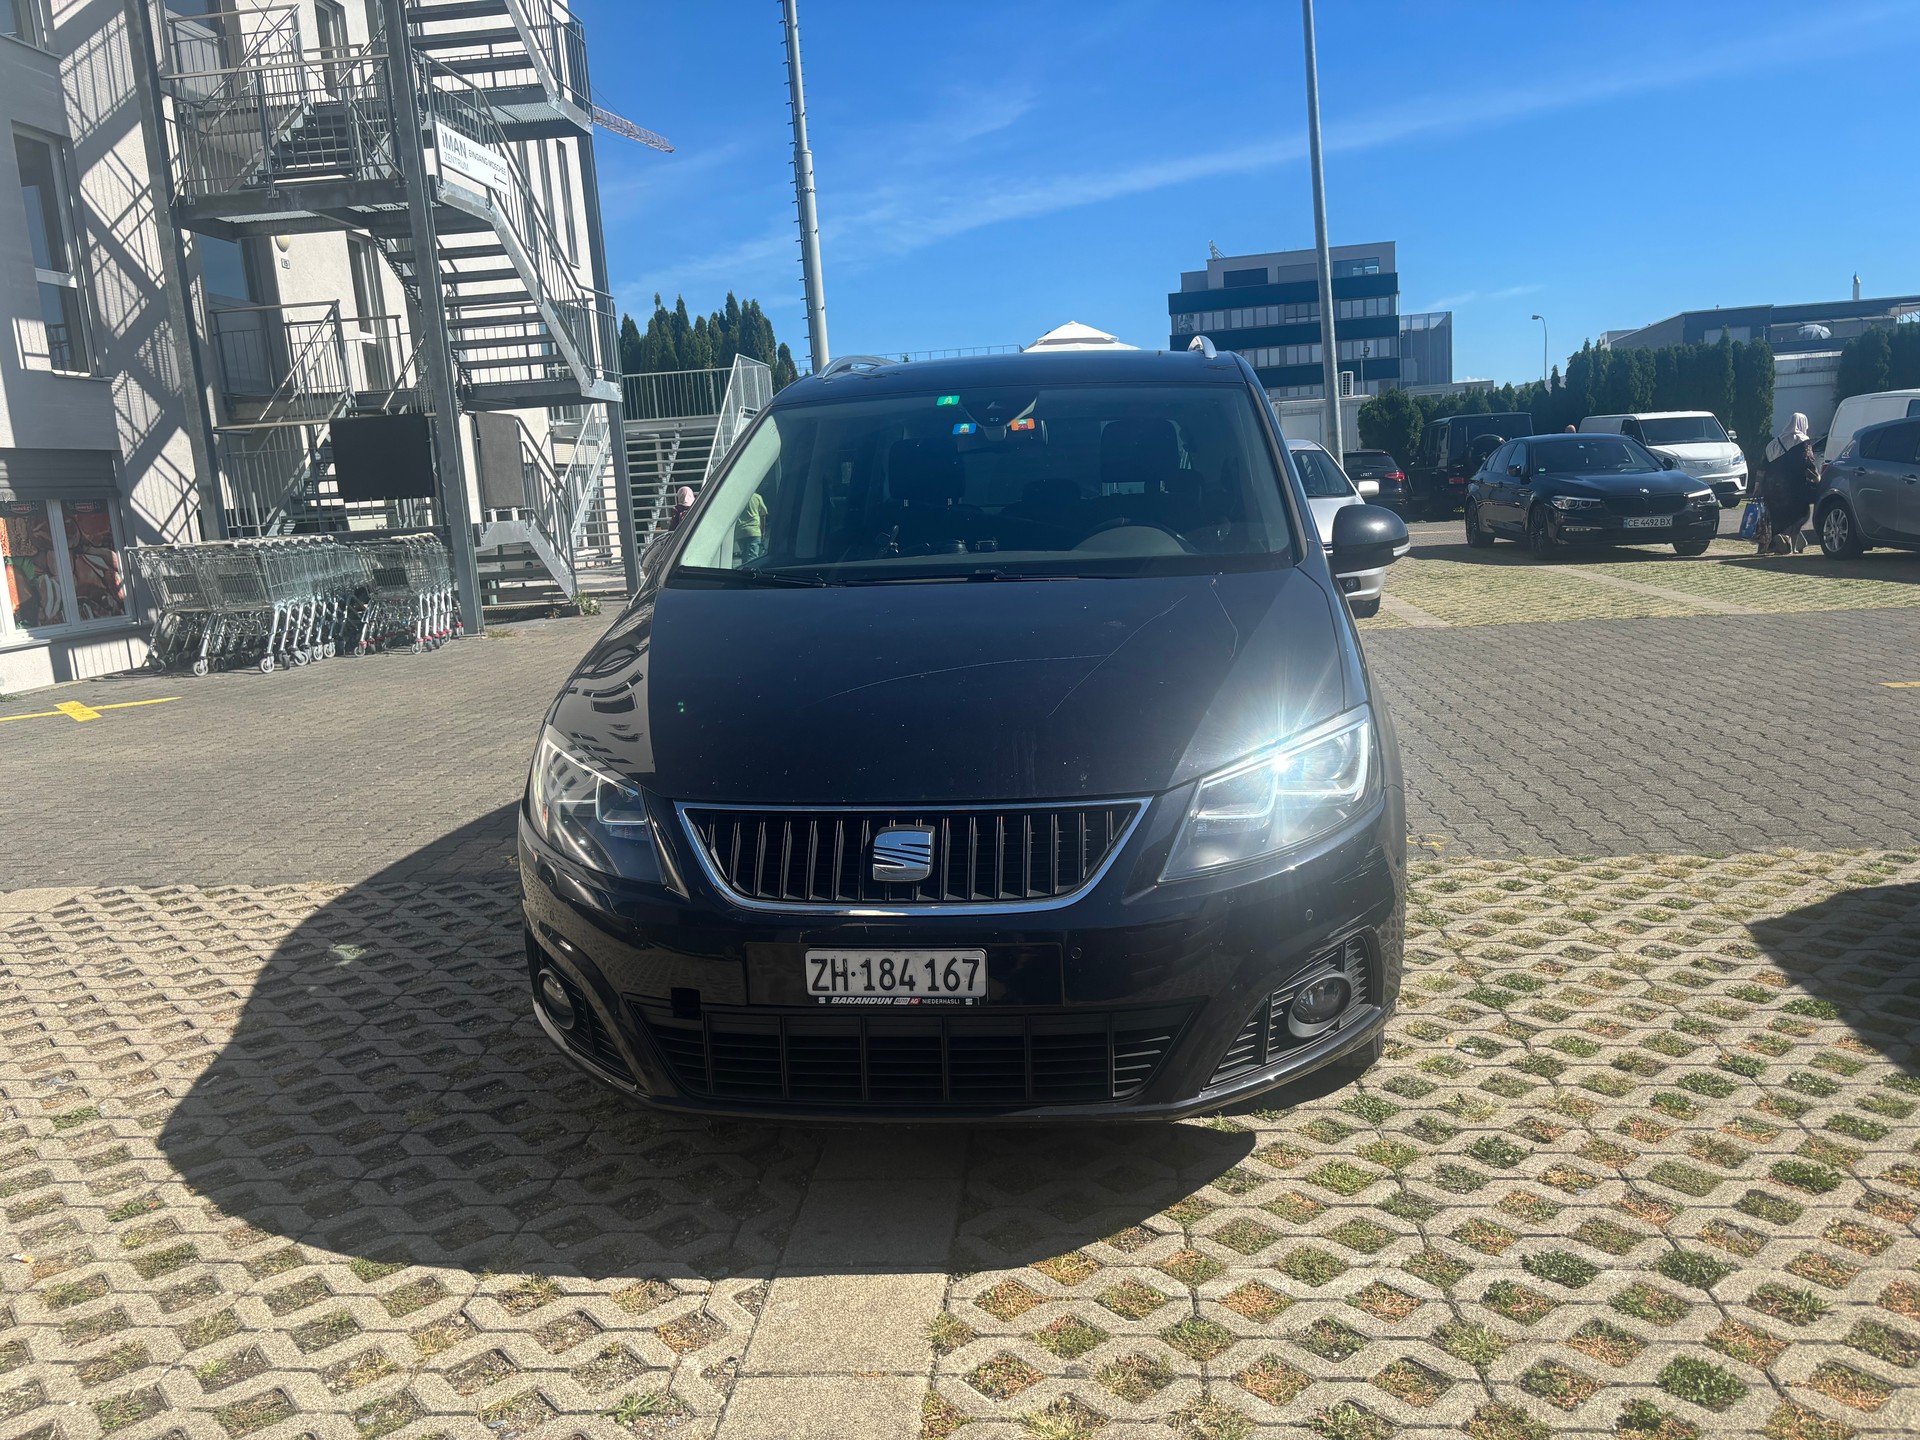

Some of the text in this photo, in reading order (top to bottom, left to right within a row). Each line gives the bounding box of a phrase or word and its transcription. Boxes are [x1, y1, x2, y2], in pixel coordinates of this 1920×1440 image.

[444, 152, 469, 171] ZENTRUM
[1628, 518, 1671, 527] CE 4492 BX
[924, 957, 980, 992] 167
[830, 997, 894, 1005] BARANDUN
